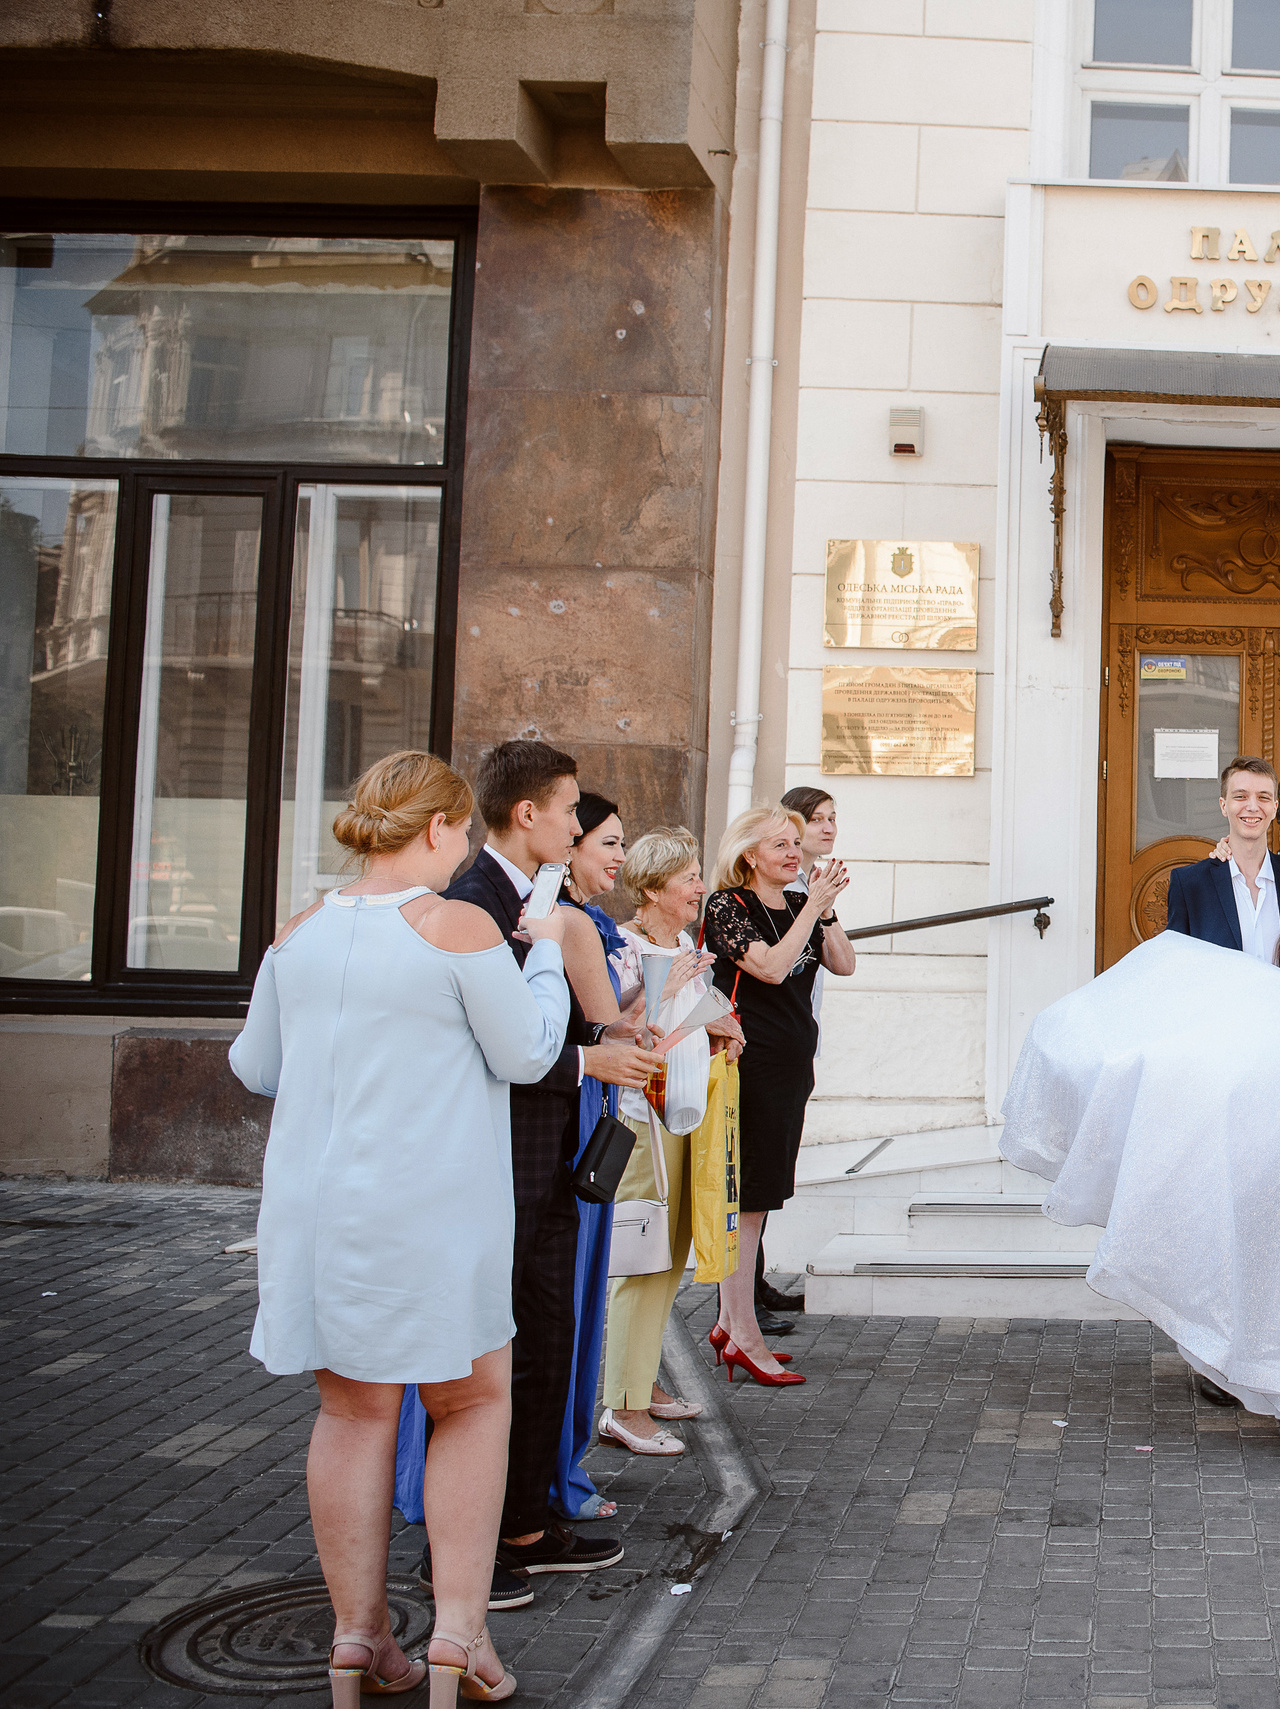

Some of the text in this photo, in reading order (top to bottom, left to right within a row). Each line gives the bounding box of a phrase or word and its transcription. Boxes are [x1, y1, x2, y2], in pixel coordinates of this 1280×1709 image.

[837, 582, 964, 595] ОДЕСЬКА МІСЬКА РАДА
